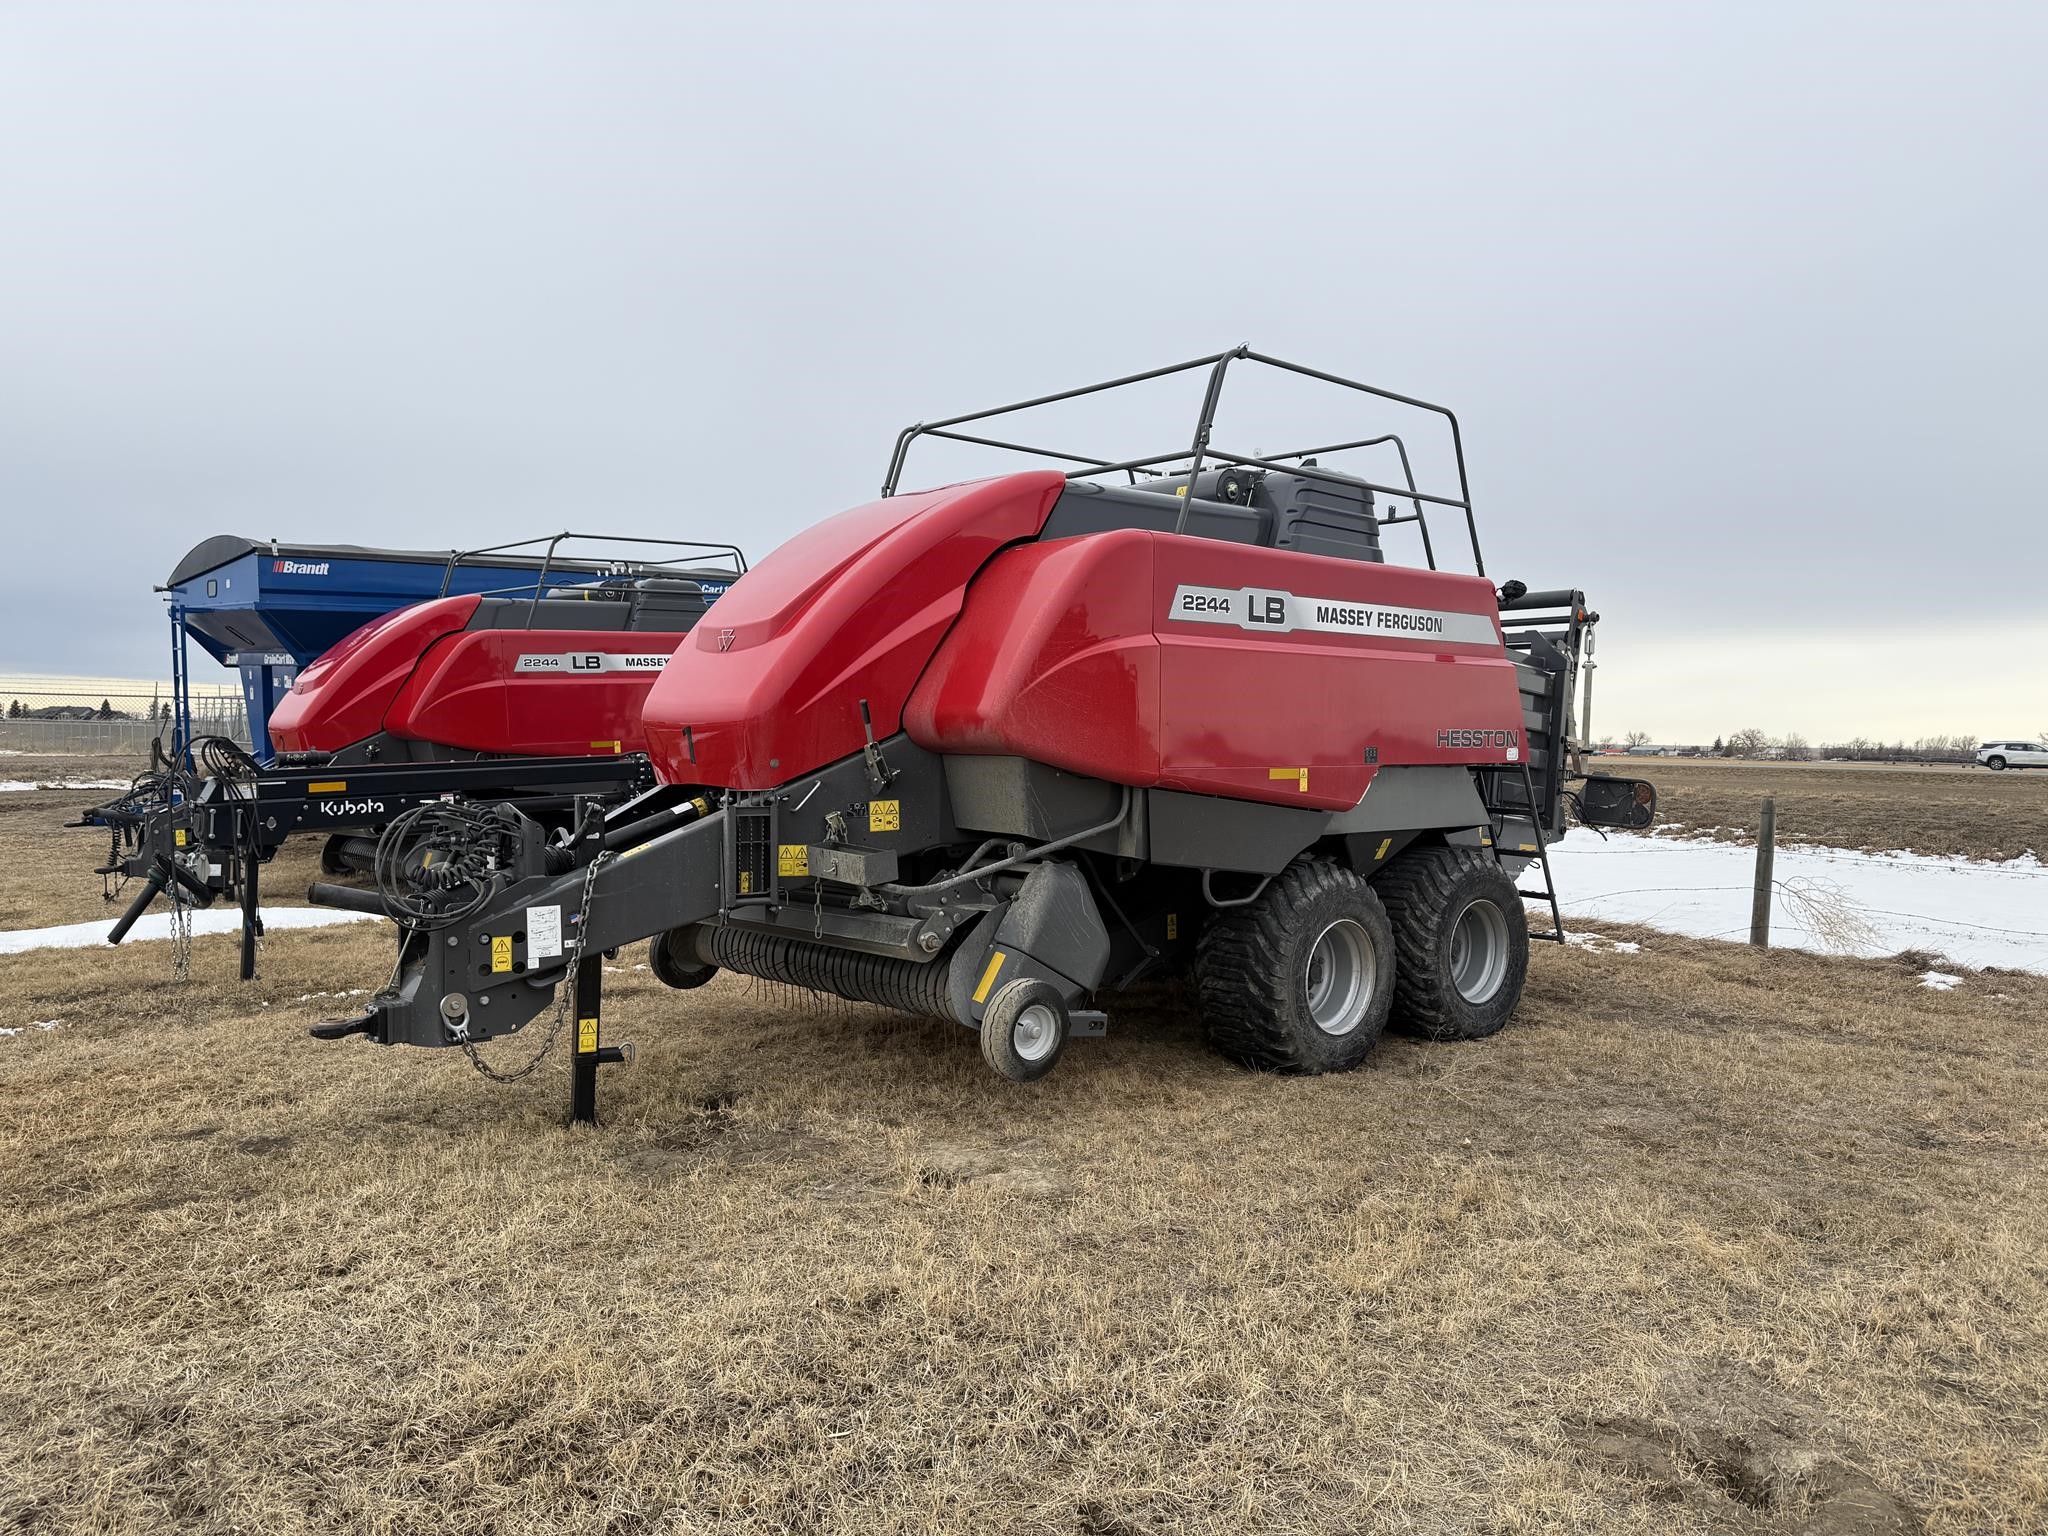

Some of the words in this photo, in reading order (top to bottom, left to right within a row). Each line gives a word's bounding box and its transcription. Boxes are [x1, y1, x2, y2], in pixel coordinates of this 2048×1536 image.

[283, 561, 329, 575] Brandt
[701, 584, 723, 593] Cart
[1182, 594, 1231, 614] 2244
[1248, 594, 1285, 624] LB
[1316, 606, 1373, 627] MASSEY
[1377, 611, 1443, 633] FERGUSON
[523, 658, 559, 667] 2244
[572, 655, 601, 669] LB
[625, 657, 670, 667] MASSEY
[1437, 729, 1519, 748] HESSTON
[320, 799, 385, 816] Kubota
